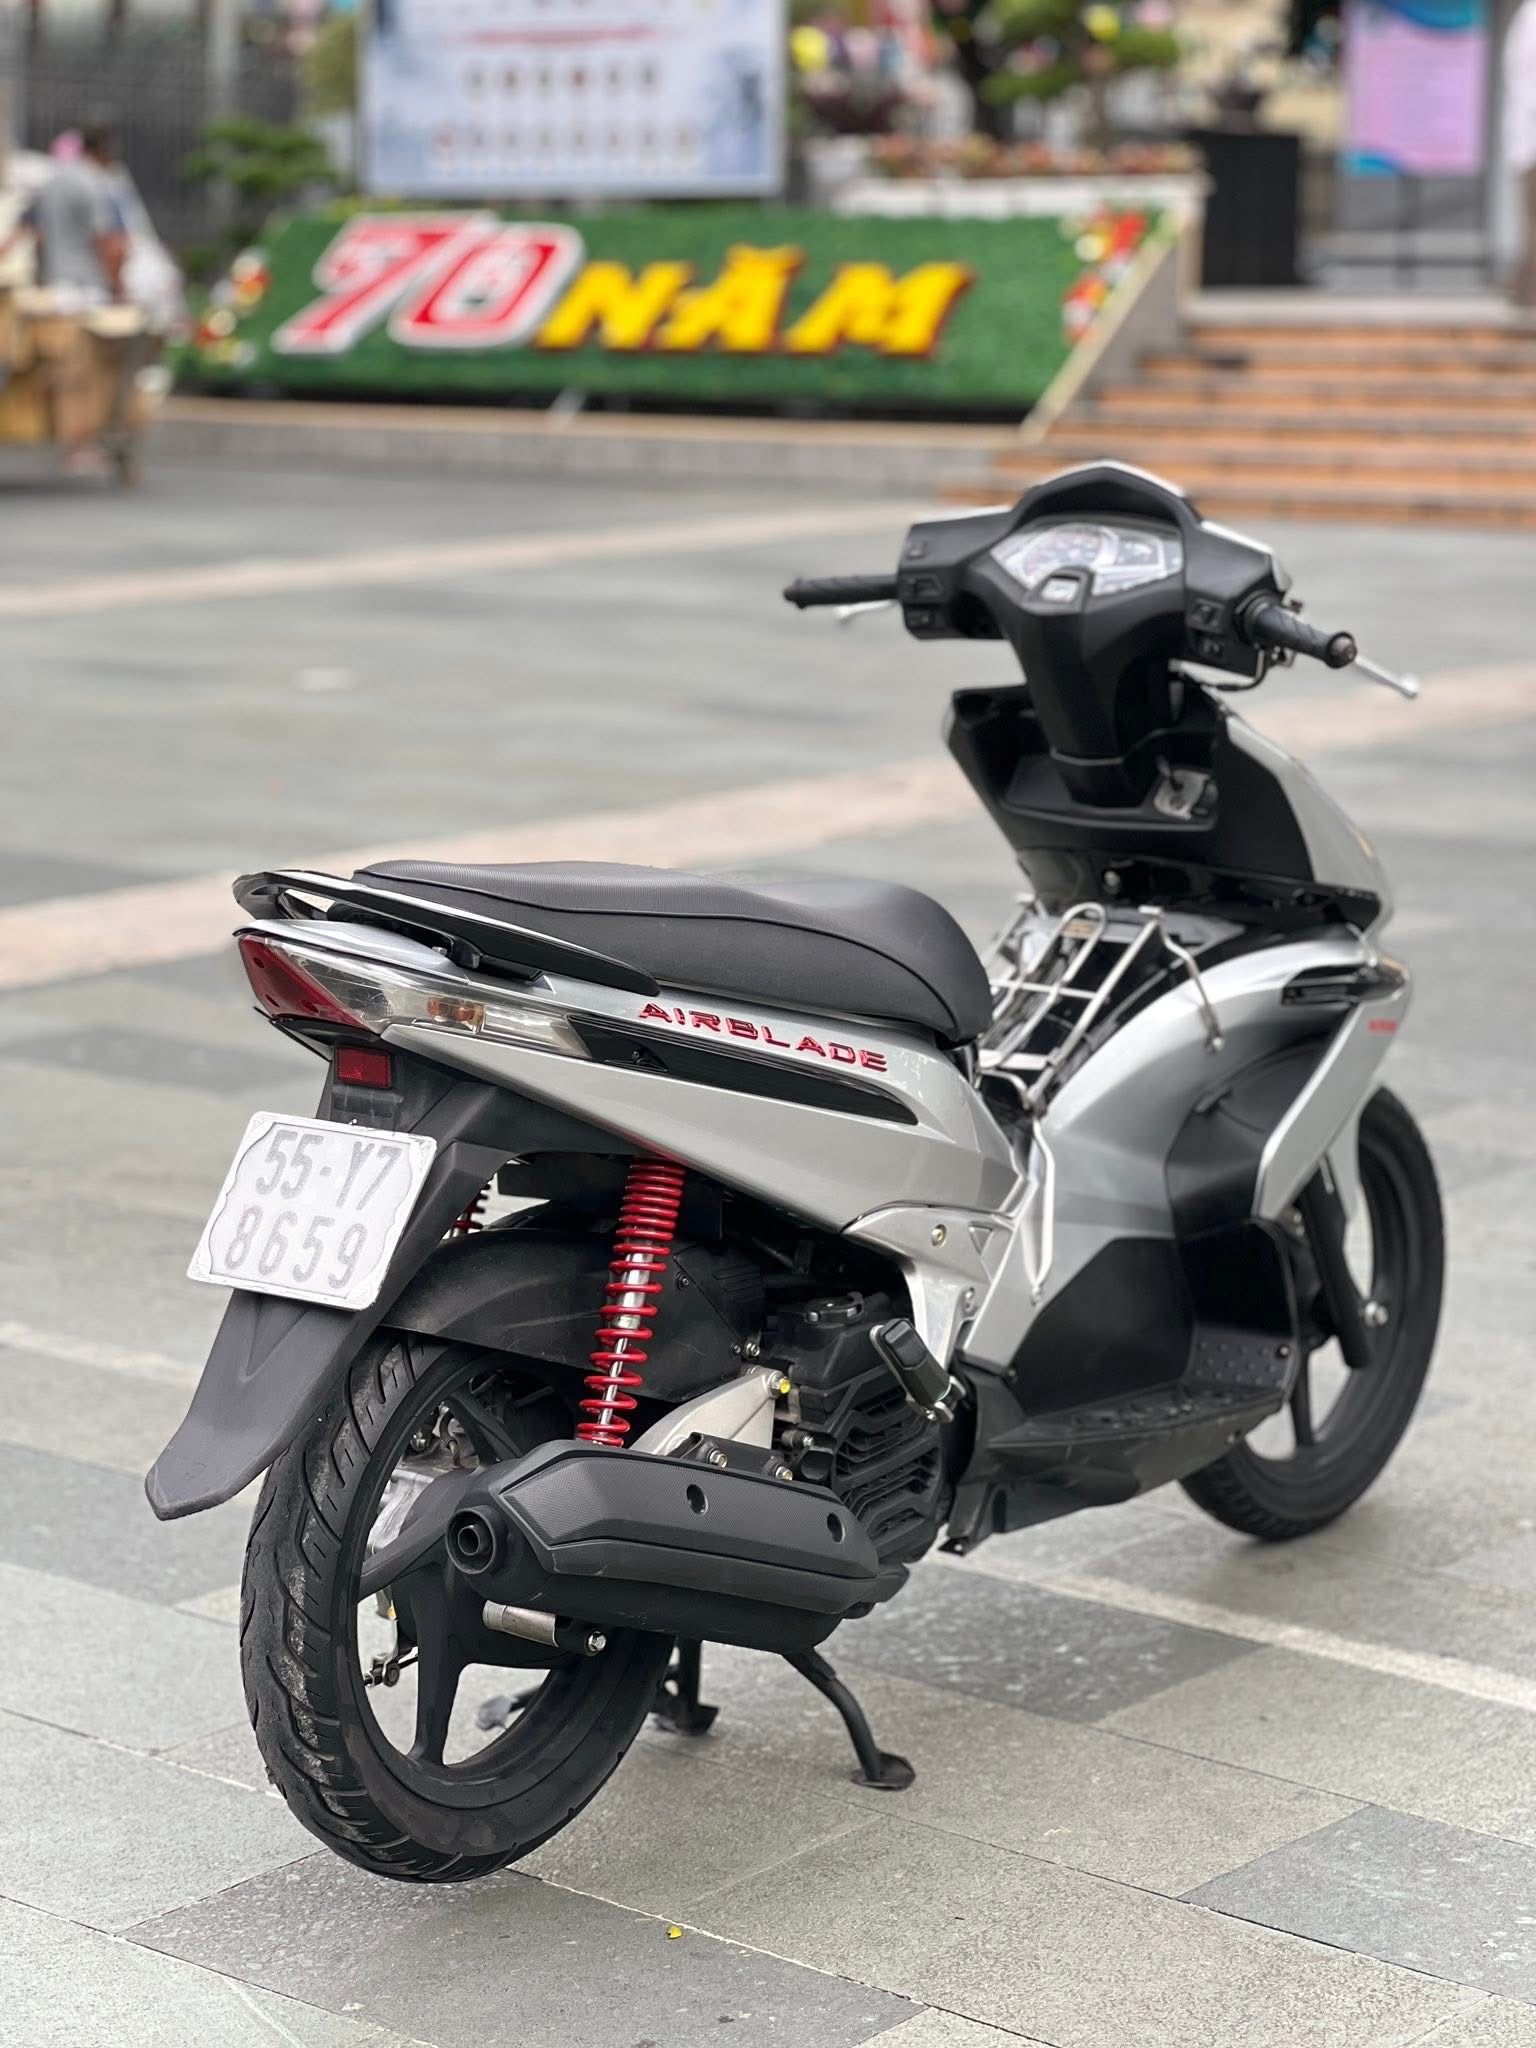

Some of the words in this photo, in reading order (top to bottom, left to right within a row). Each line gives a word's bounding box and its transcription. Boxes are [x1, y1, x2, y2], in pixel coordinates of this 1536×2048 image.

[271, 210, 585, 354] 70
[533, 244, 974, 359] NĂM
[638, 1003, 887, 1072] AIRBLADE
[256, 1129, 403, 1211] 55-Y7
[224, 1205, 368, 1289] 8659
